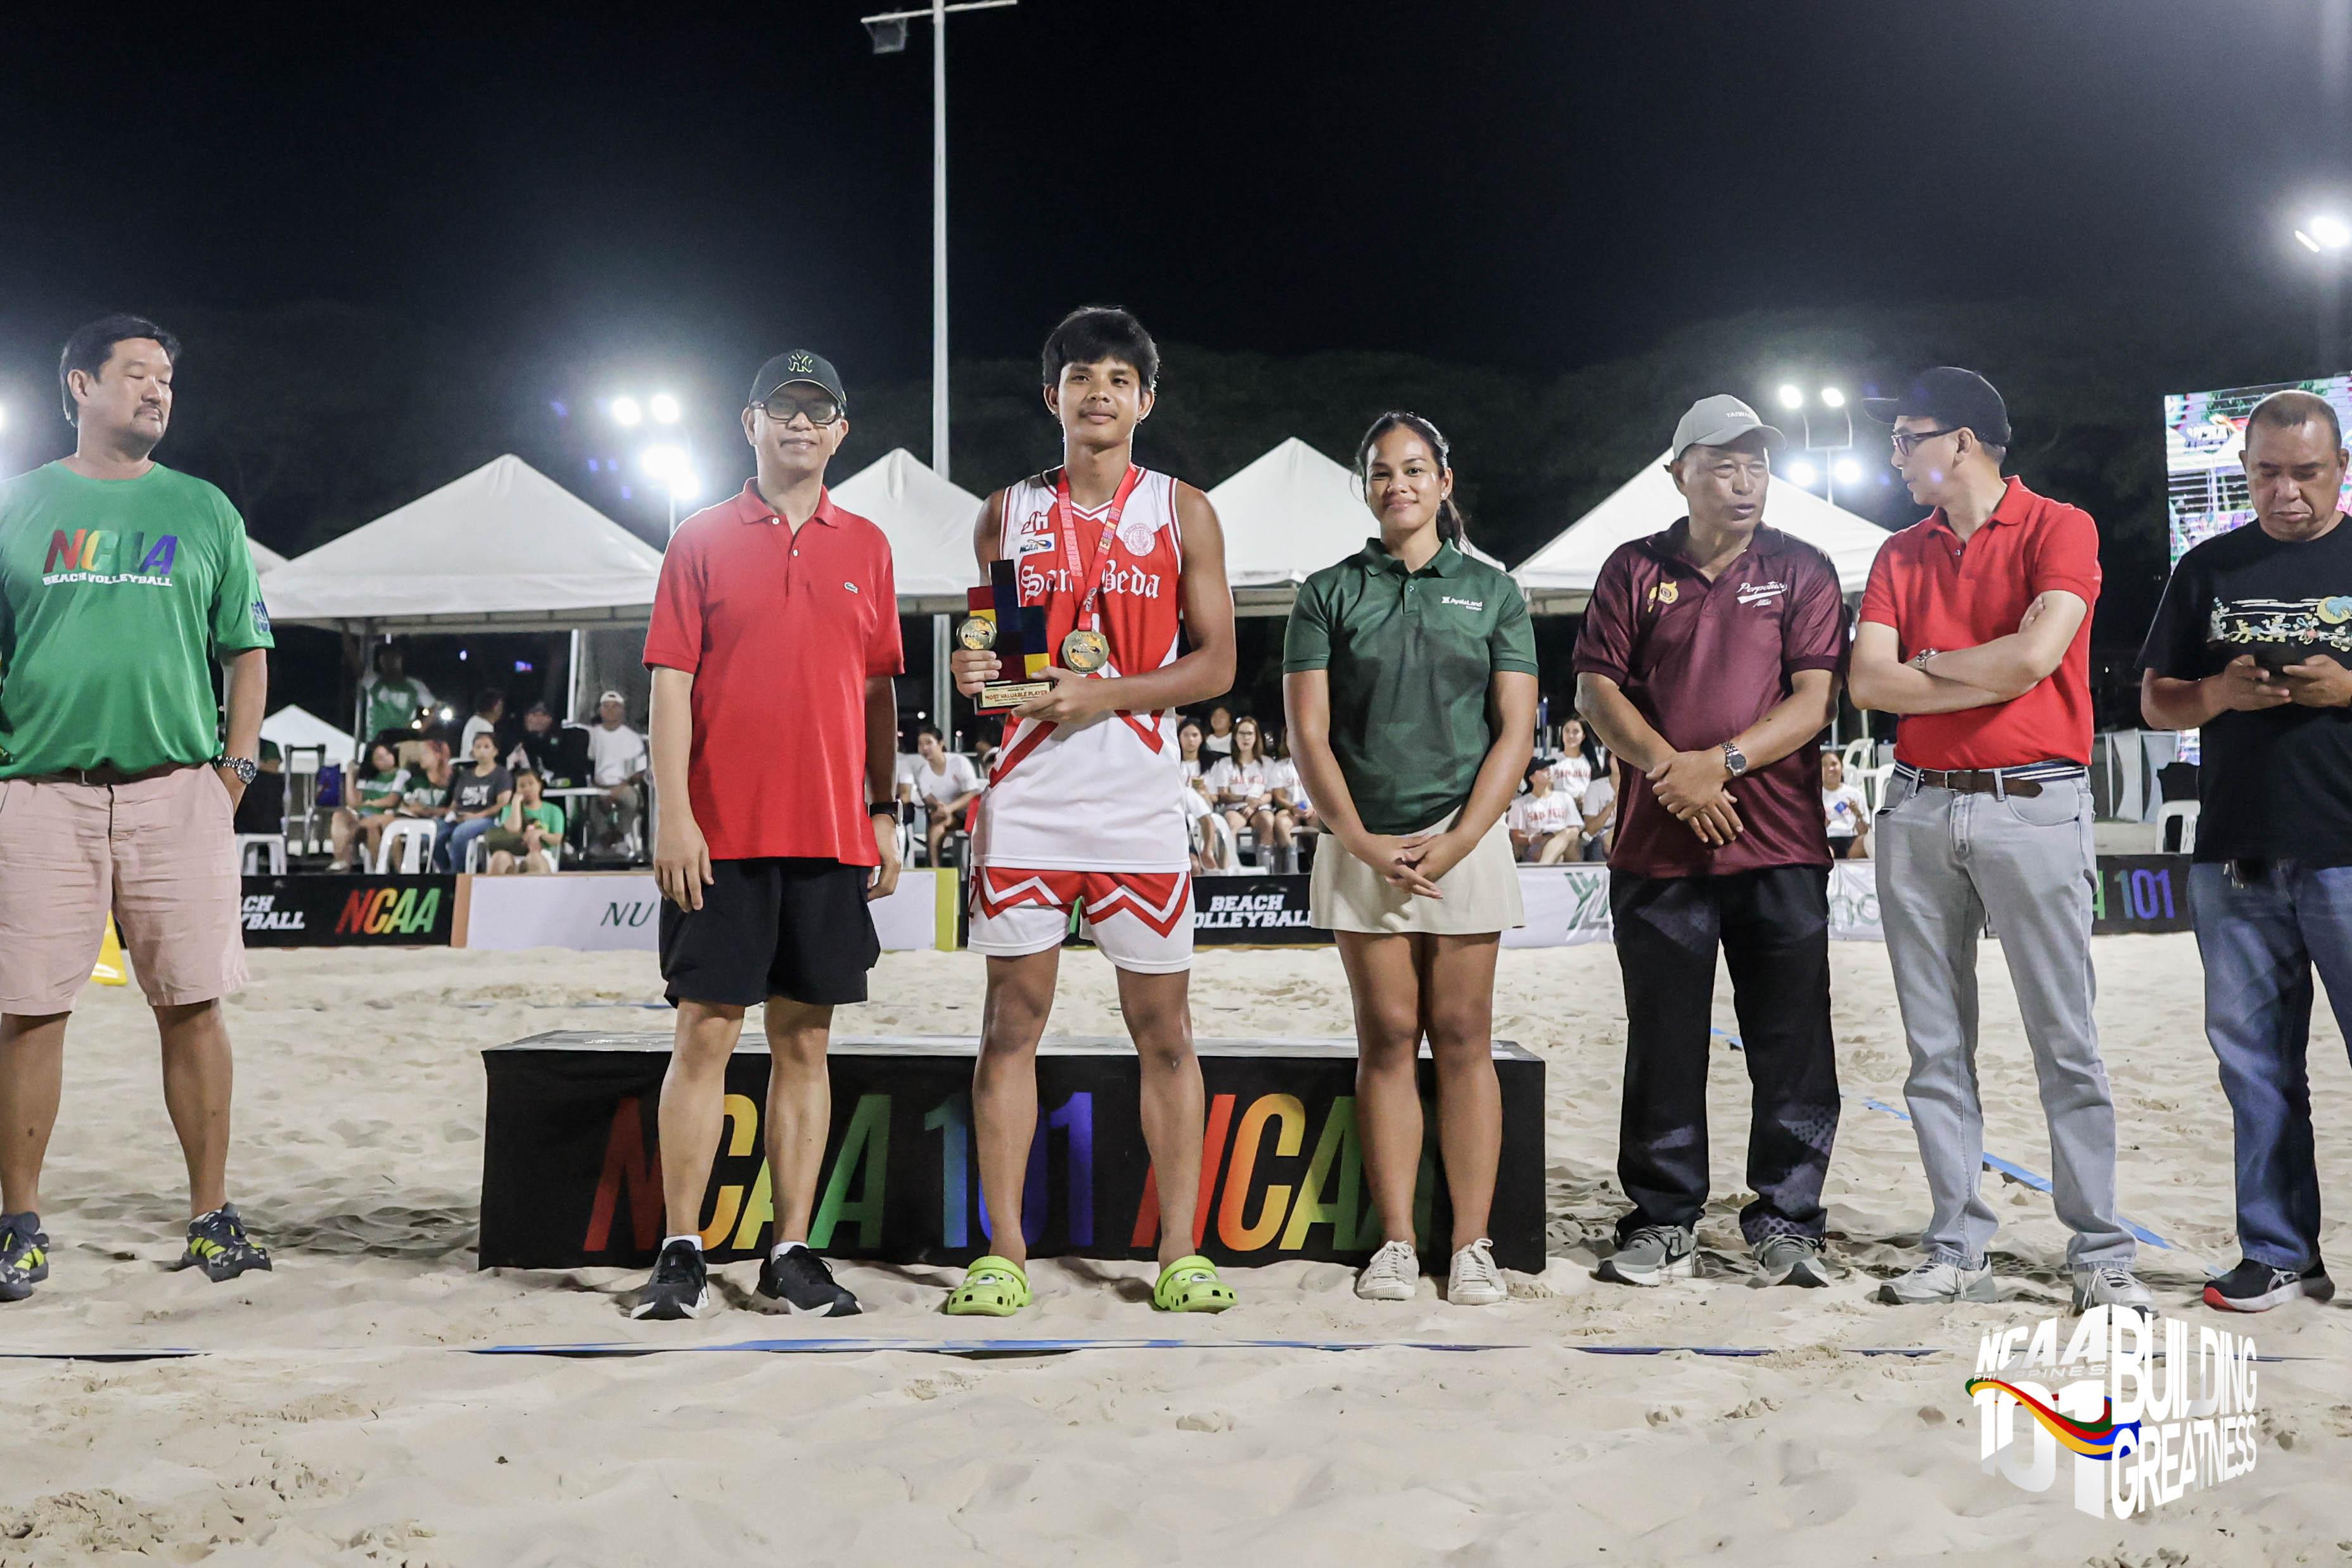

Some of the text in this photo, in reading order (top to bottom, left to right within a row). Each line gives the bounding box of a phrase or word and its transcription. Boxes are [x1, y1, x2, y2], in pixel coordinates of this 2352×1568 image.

[42, 572, 173, 587] BEACH VOLLEYBALL
[1021, 559, 1161, 601] San Beda
[335, 888, 441, 935] NCAA
[1209, 895, 1284, 912] BEACH
[2114, 869, 2175, 919] 101
[1194, 910, 1312, 929] OLLEYBAL
[1130, 1093, 1435, 1252] NCA
